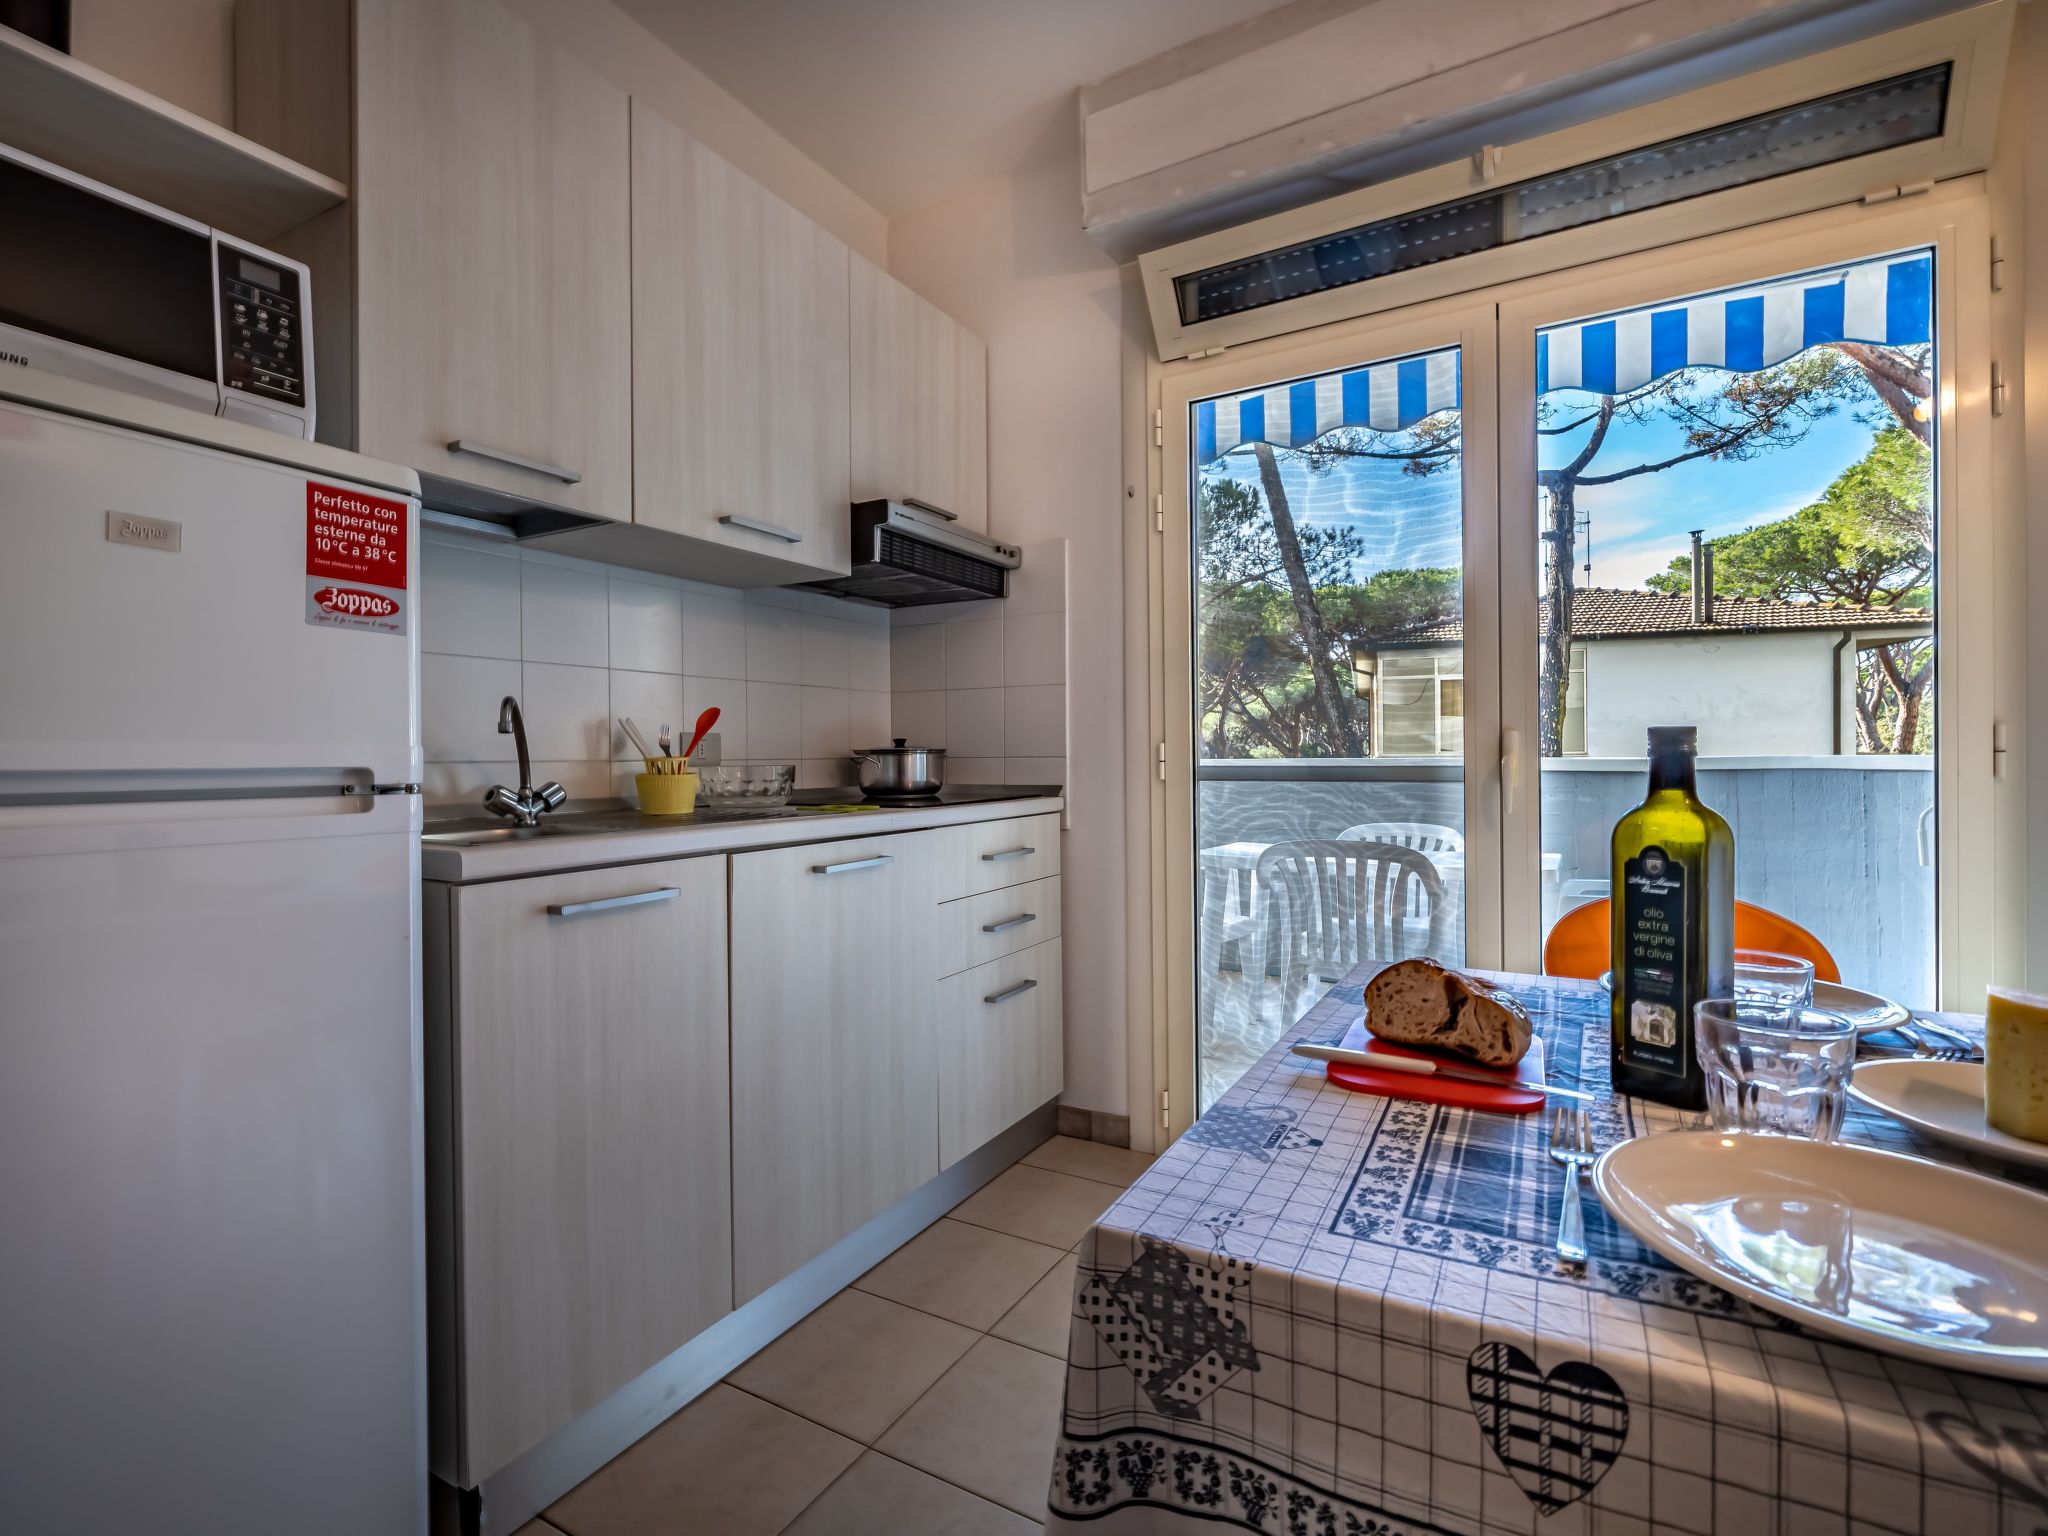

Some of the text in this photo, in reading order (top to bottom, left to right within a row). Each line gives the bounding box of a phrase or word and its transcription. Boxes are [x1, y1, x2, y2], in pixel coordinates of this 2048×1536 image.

[314, 490, 397, 520] Perfetto con
[314, 507, 398, 534] temperature
[314, 524, 386, 546] esterne da
[316, 537, 397, 562] 10°C a 38°C
[321, 586, 392, 614] Zoppas
[1643, 907, 1664, 919] olio
[1638, 920, 1669, 932] extra
[1633, 931, 1675, 946] vergine
[1634, 946, 1673, 961] di oliva
